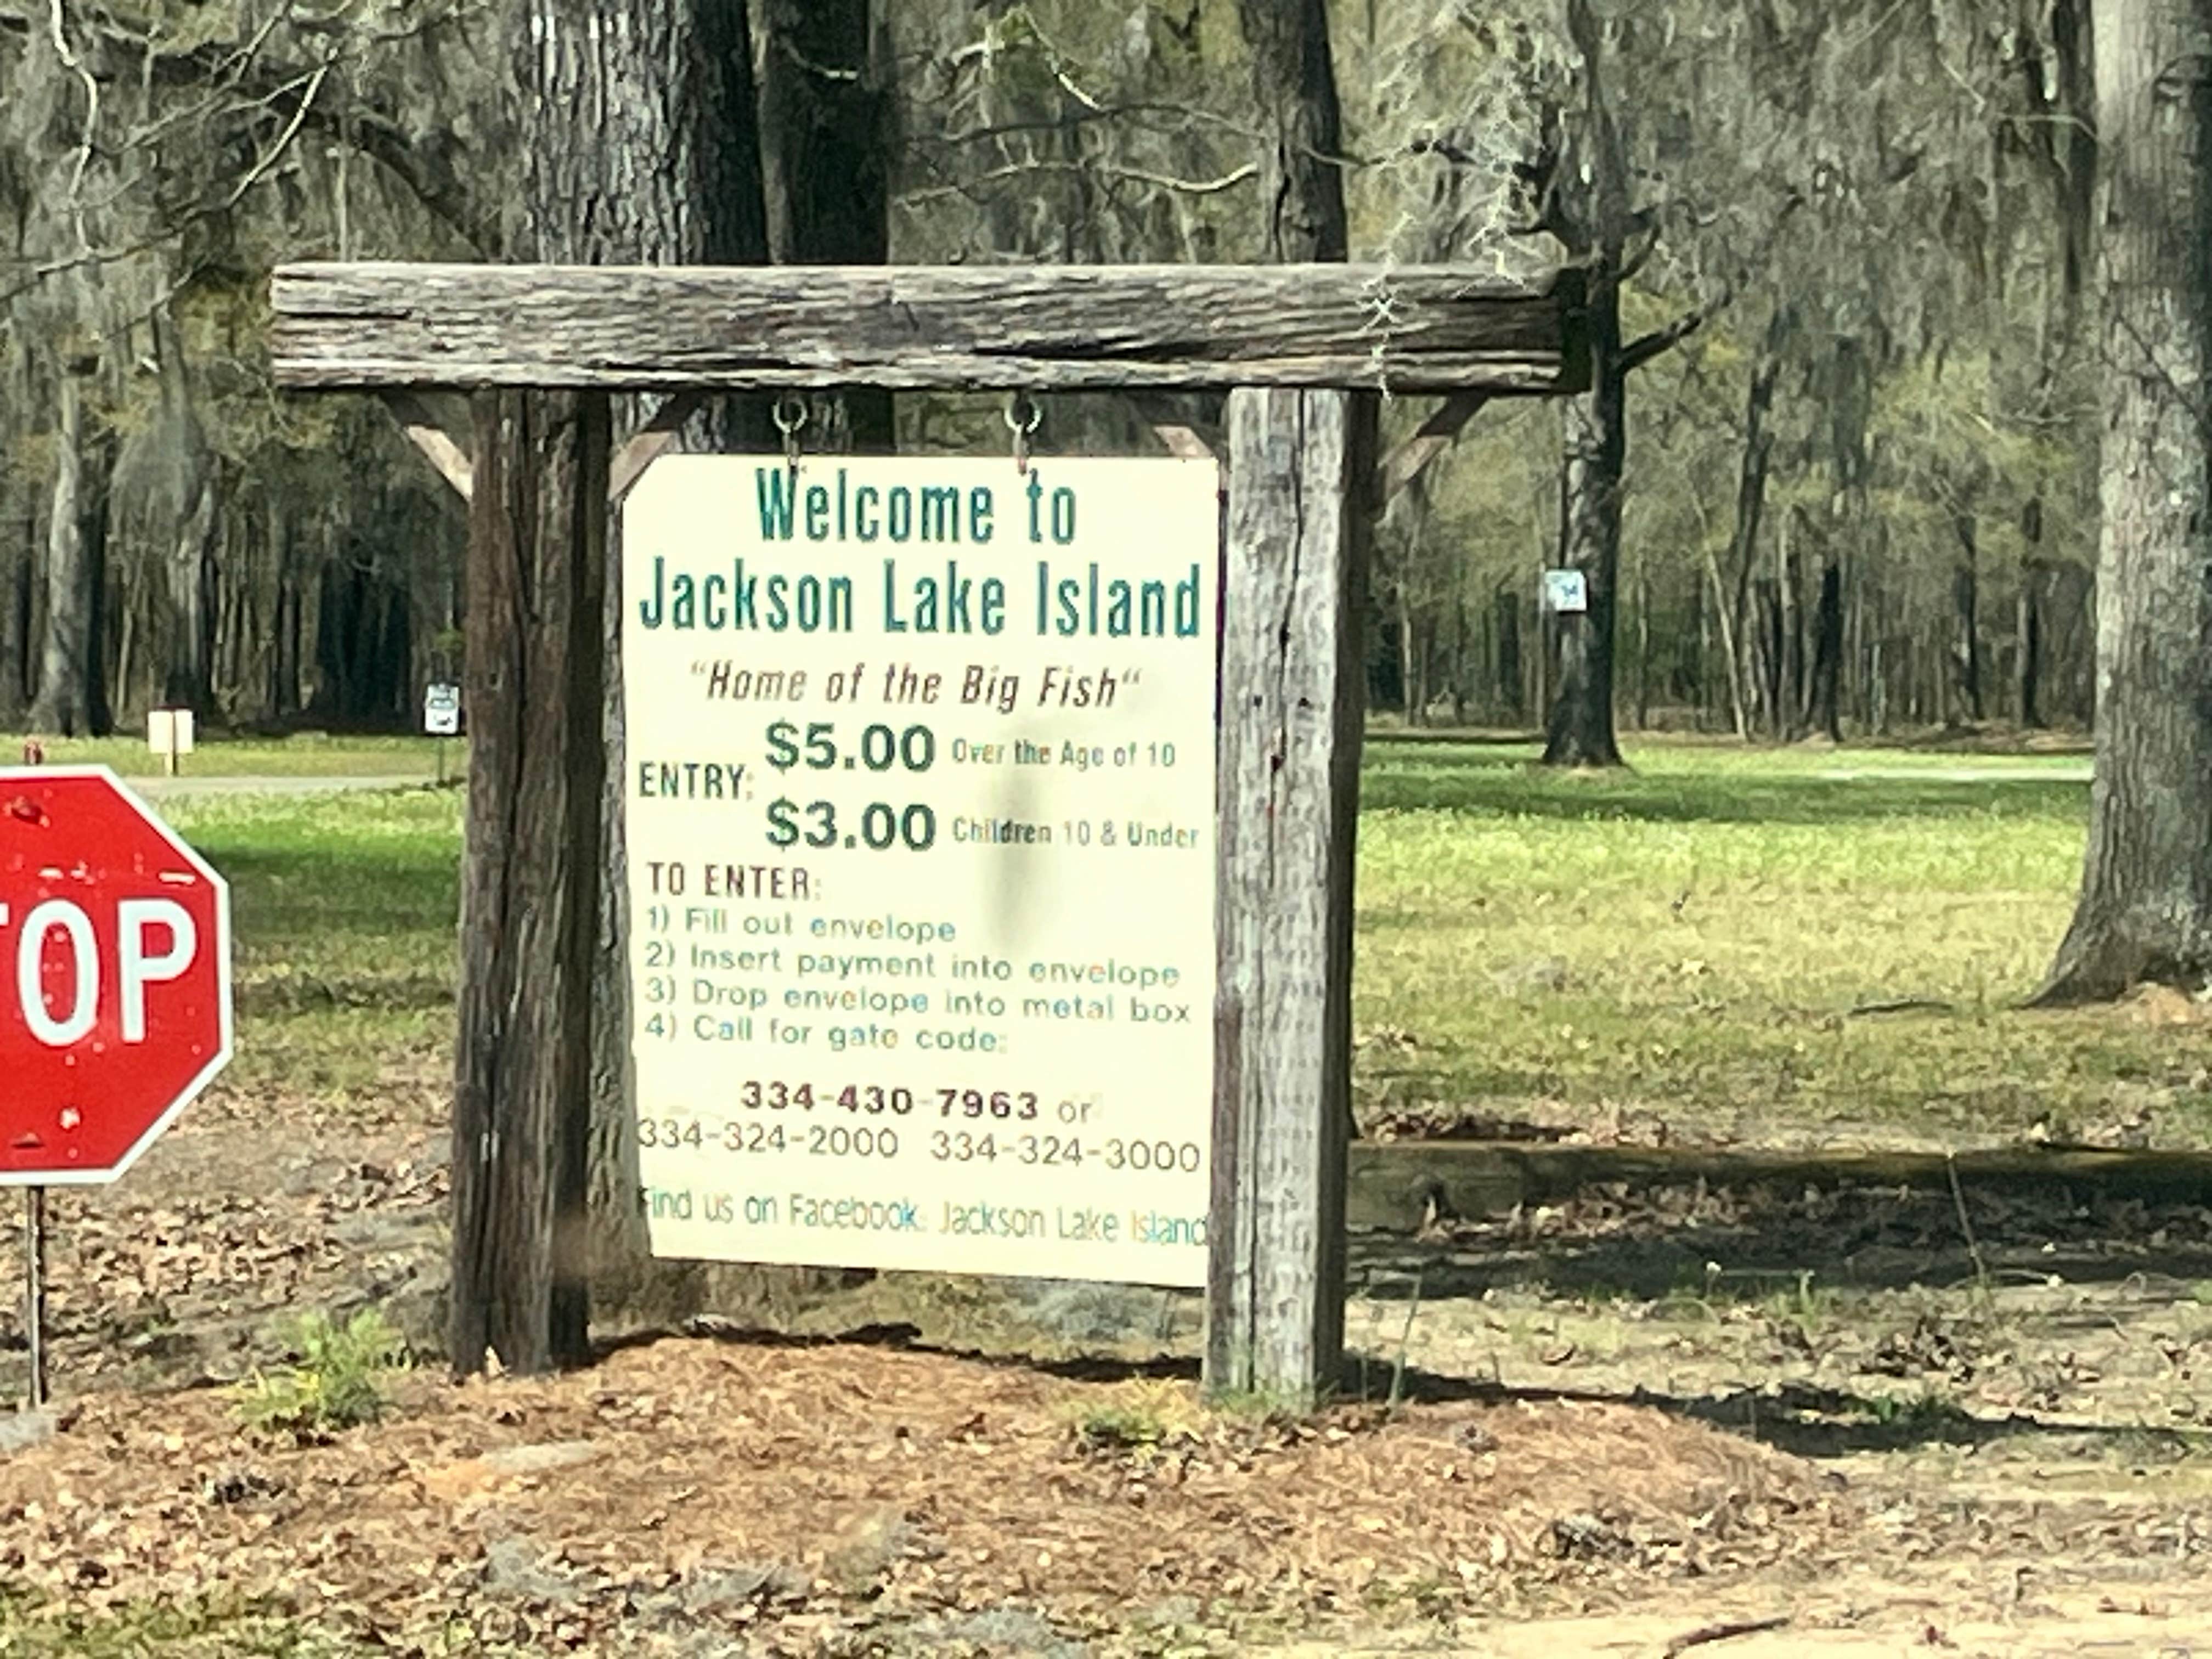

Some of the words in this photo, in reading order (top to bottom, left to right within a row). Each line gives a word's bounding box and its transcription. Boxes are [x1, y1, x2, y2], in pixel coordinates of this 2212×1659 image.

[755, 467, 994, 543] Welcome
[1026, 469, 1076, 545] to
[639, 555, 854, 632] Jackson
[883, 557, 1006, 635] Lake
[1036, 560, 1202, 638] Island
[825, 662, 865, 701] of
[883, 663, 941, 705] the
[960, 665, 1020, 714] Big
[765, 718, 936, 776] $5.00
[951, 737, 1005, 766] Over
[1014, 738, 1052, 766] the
[1059, 738, 1104, 772] Age
[1113, 741, 1138, 768] of
[1147, 742, 1176, 767] 10
[639, 761, 754, 802] ENTRY:
[765, 797, 936, 853] $3.00
[951, 815, 1052, 845] Children
[1063, 820, 1092, 846] 10
[1099, 821, 1117, 847] &
[1127, 822, 1200, 849] Under
[647, 861, 685, 898] TO
[705, 863, 822, 901] ENTER:
[647, 906, 669, 932] 1)
[684, 906, 727, 934] Fill
[742, 911, 794, 936] out
[810, 913, 957, 943] envelope
[0, 899, 196, 1047] OP
[645, 942, 676, 968] 2)
[690, 944, 781, 972] Insert
[798, 949, 936, 978] payment
[951, 954, 1013, 980] into
[1028, 960, 1181, 989] envelope
[645, 978, 676, 1005] 3)
[692, 980, 767, 1010] Drop
[784, 988, 930, 1015] envelope
[946, 990, 1007, 1017] into
[1023, 994, 1114, 1019] metal
[1130, 998, 1192, 1023] box
[645, 1013, 676, 1040] 4)
[693, 1015, 752, 1042] Call
[769, 1019, 810, 1043] for
[828, 1023, 899, 1051] gate
[742, 1079, 1039, 1121] 334-430-7963
[1057, 1097, 1092, 1124] or
[637, 1118, 899, 1158] 334-324-2000
[931, 1130, 1202, 1173] 334-324-3000
[704, 1192, 735, 1224] us
[744, 1195, 778, 1225] on
[939, 1200, 1046, 1238] Jackson
[1058, 1205, 1119, 1243] Lake
